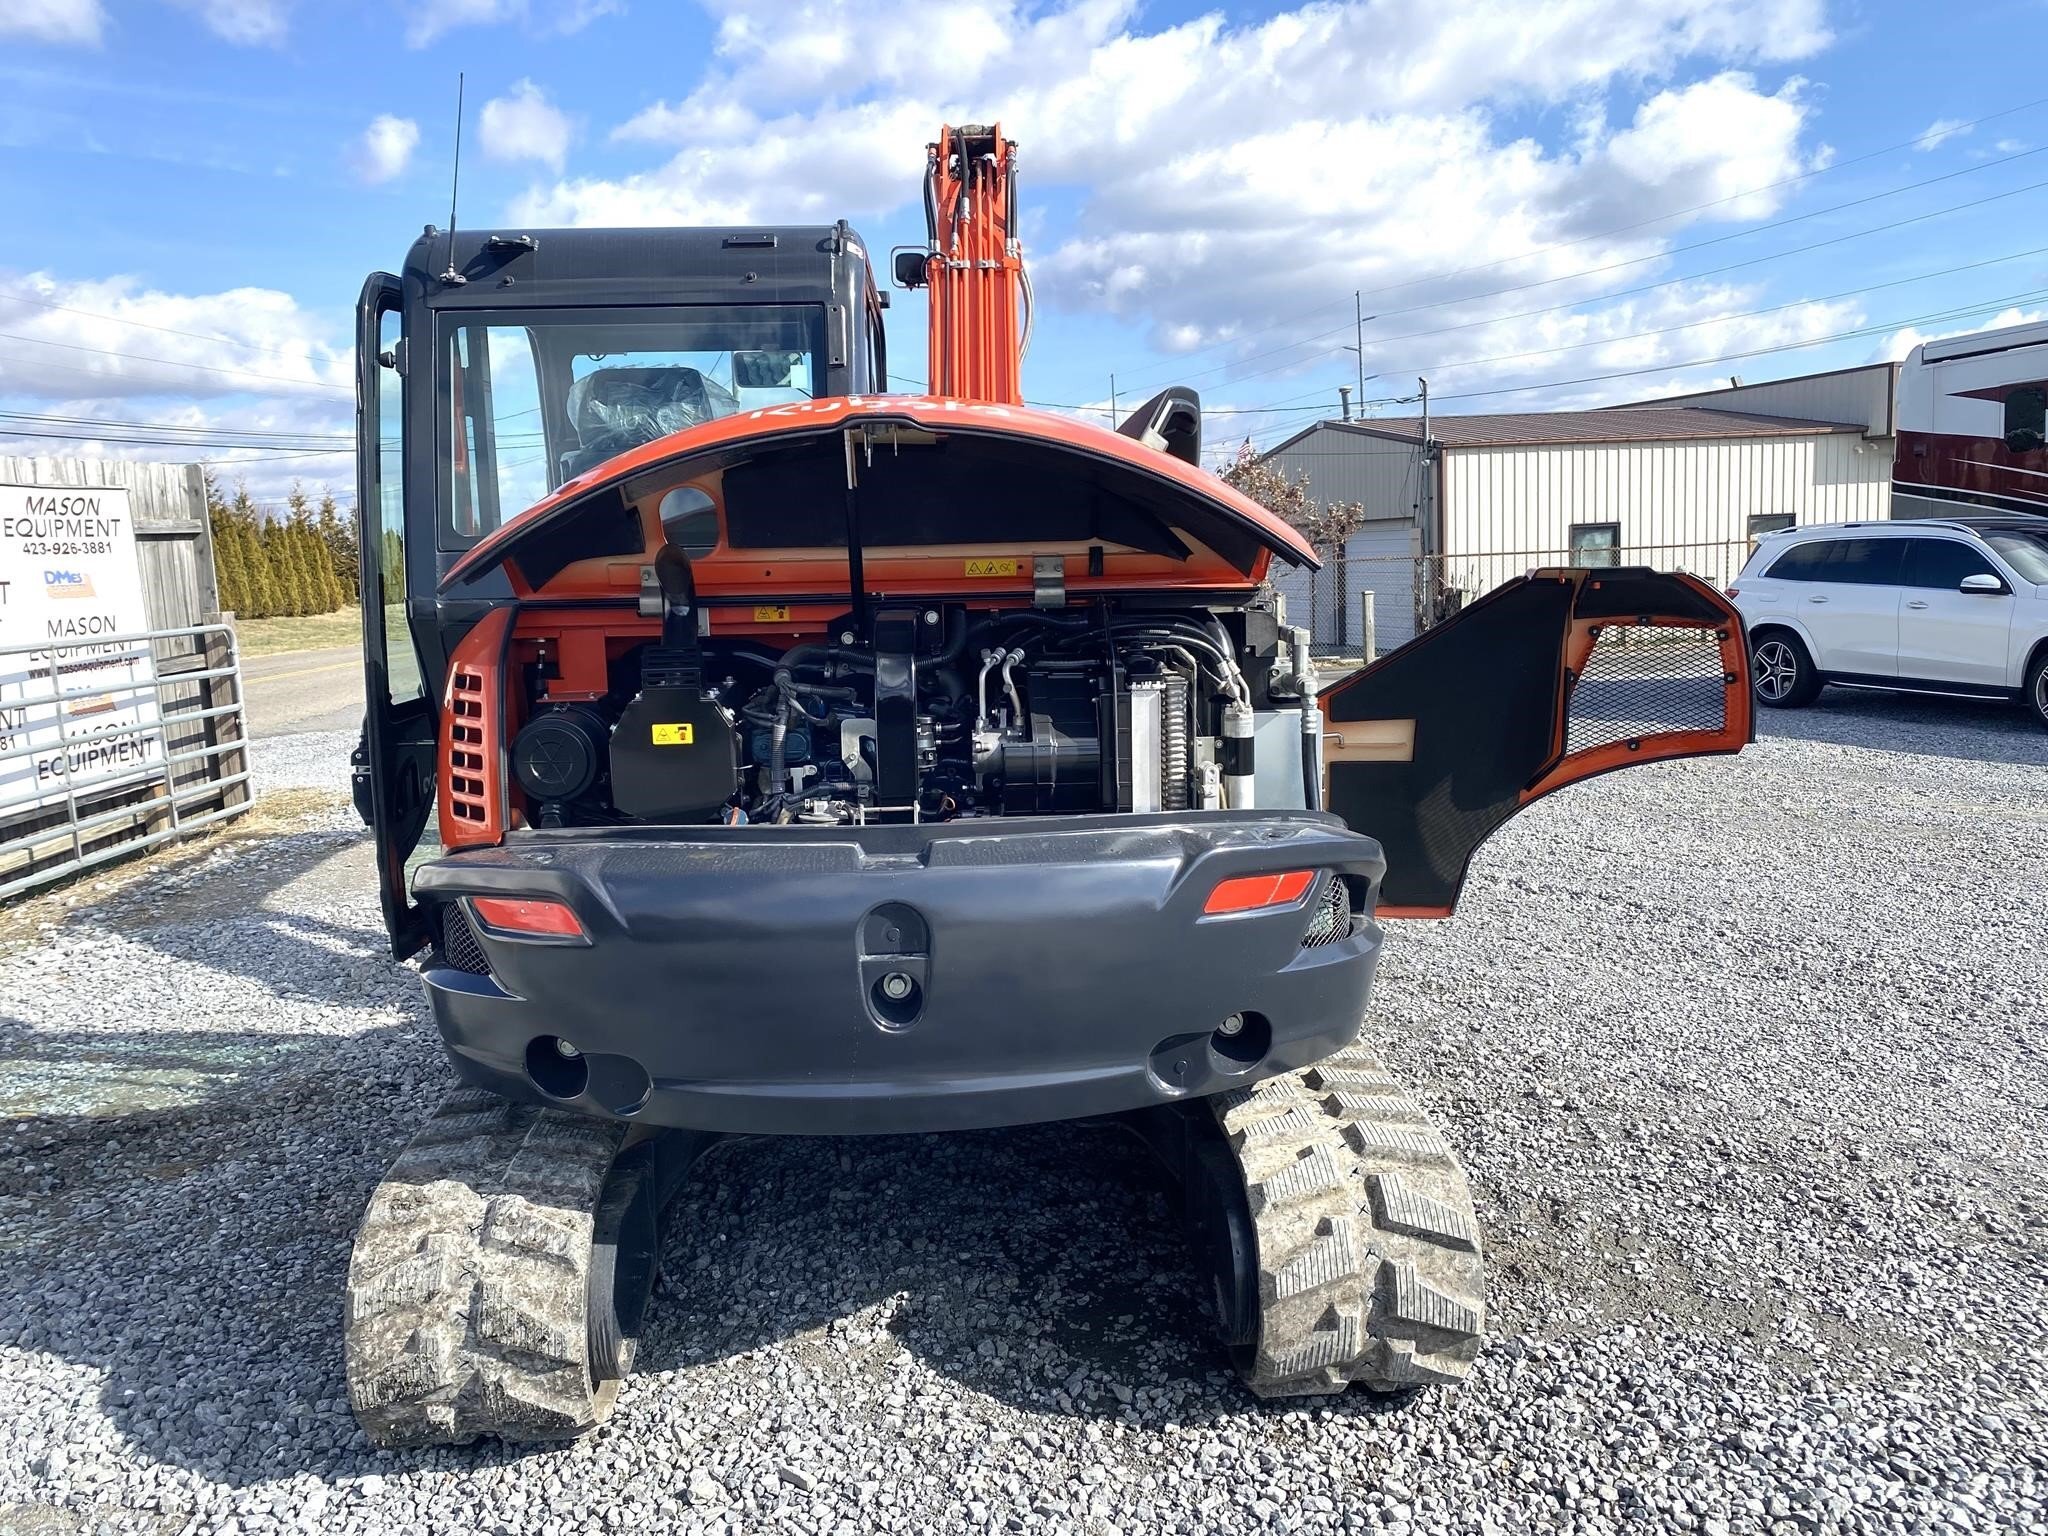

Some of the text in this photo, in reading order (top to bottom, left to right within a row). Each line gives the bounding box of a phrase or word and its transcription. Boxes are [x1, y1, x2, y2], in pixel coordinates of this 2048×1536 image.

[25, 496, 101, 516] MASON
[4, 518, 121, 538] EQUIPMENT
[23, 541, 112, 555] 423-926-3881
[47, 613, 116, 638] MASON
